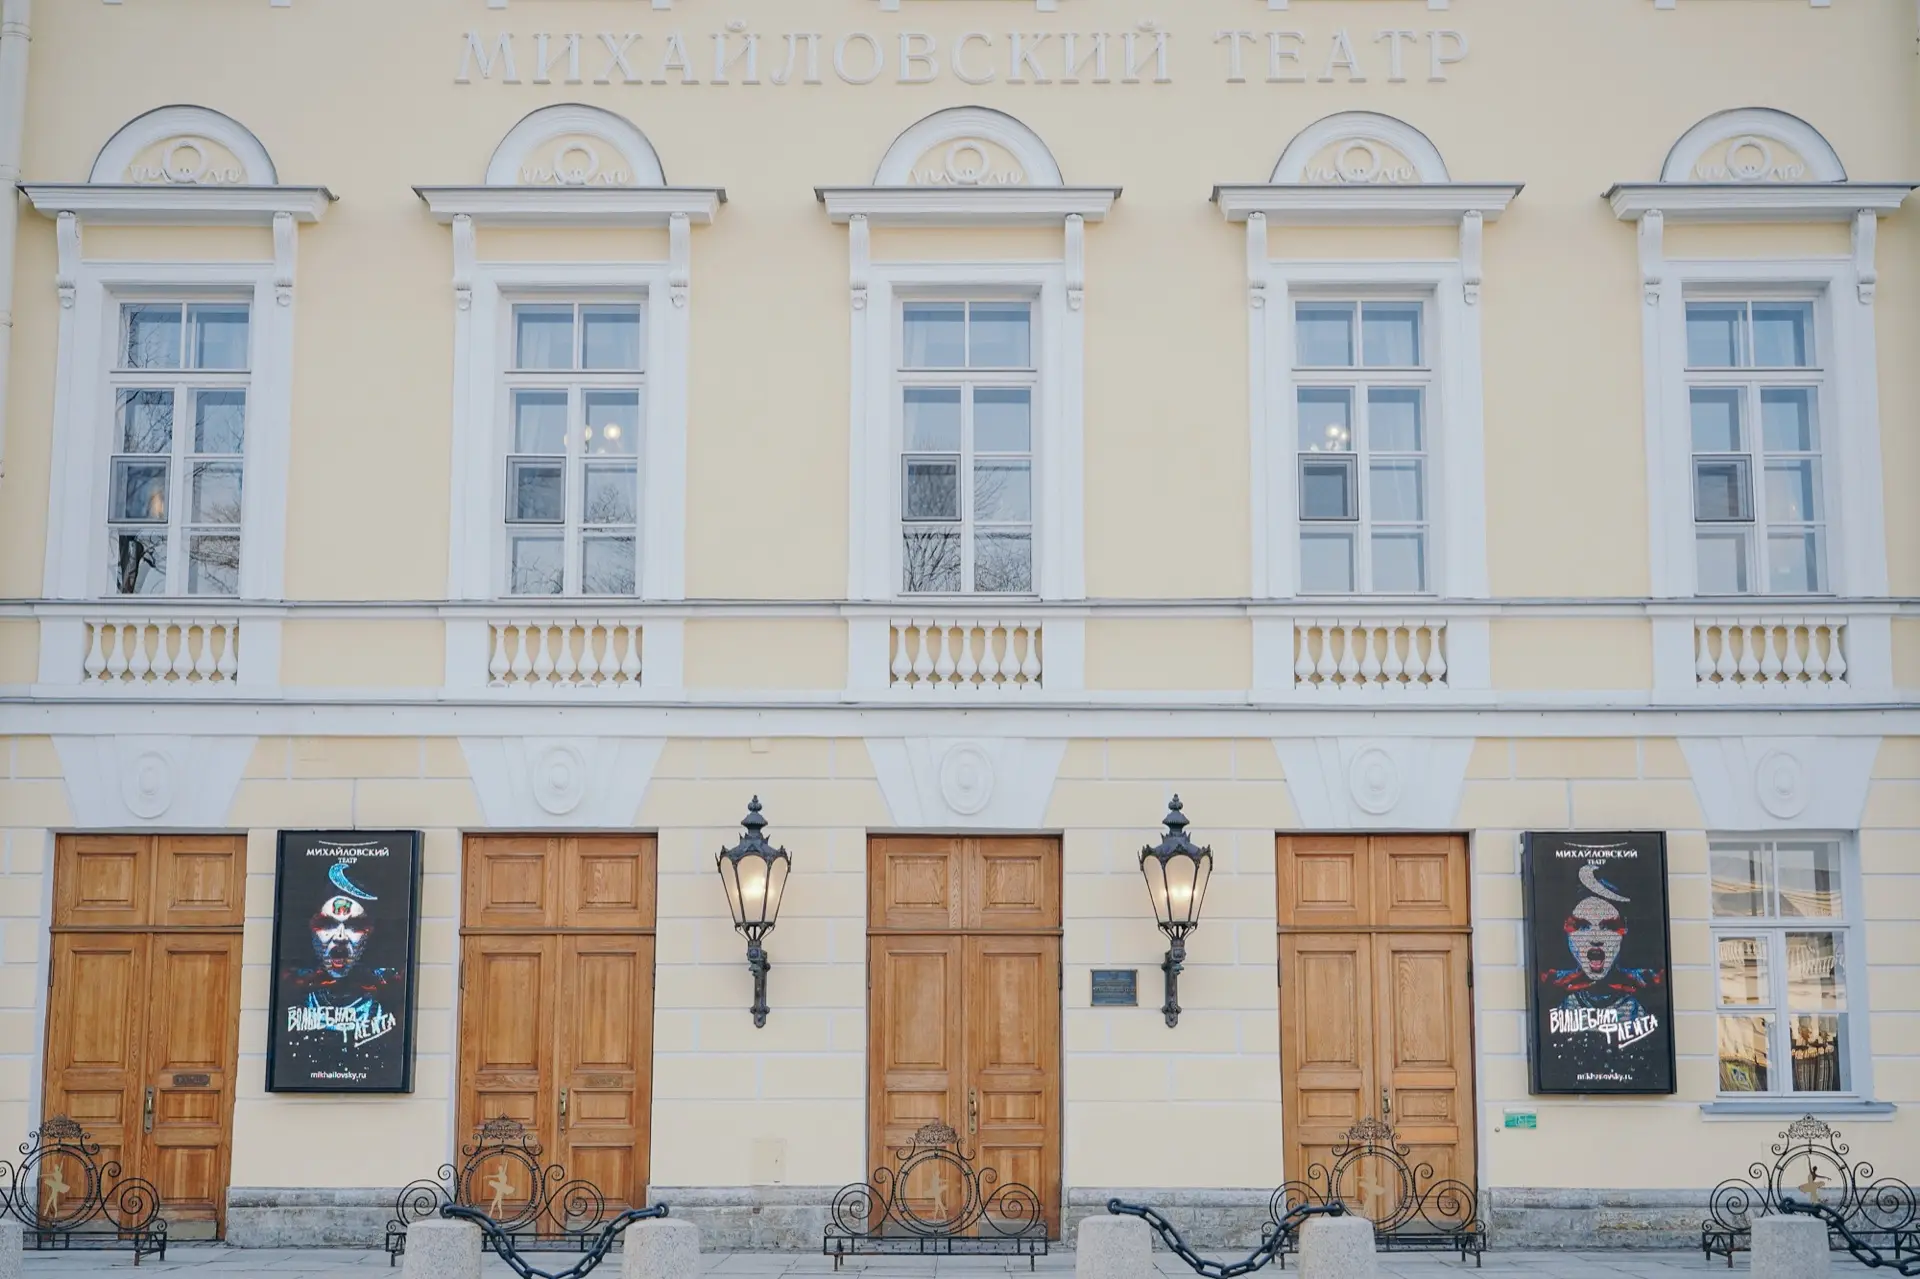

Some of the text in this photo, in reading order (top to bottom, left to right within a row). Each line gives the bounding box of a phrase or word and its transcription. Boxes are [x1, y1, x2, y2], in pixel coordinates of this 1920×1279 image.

[454, 18, 1470, 85] МИХАЙЛОВСКИЙ ТЕАТР
[306, 846, 390, 857] МИХАЙЛОВСКИЙ
[1555, 848, 1638, 858] МИХАЙЛОВСКИЙ
[1550, 1008, 1618, 1034] ВОЛШЕБНАЯ
[310, 1071, 367, 1081] mikhailovsky.ru
